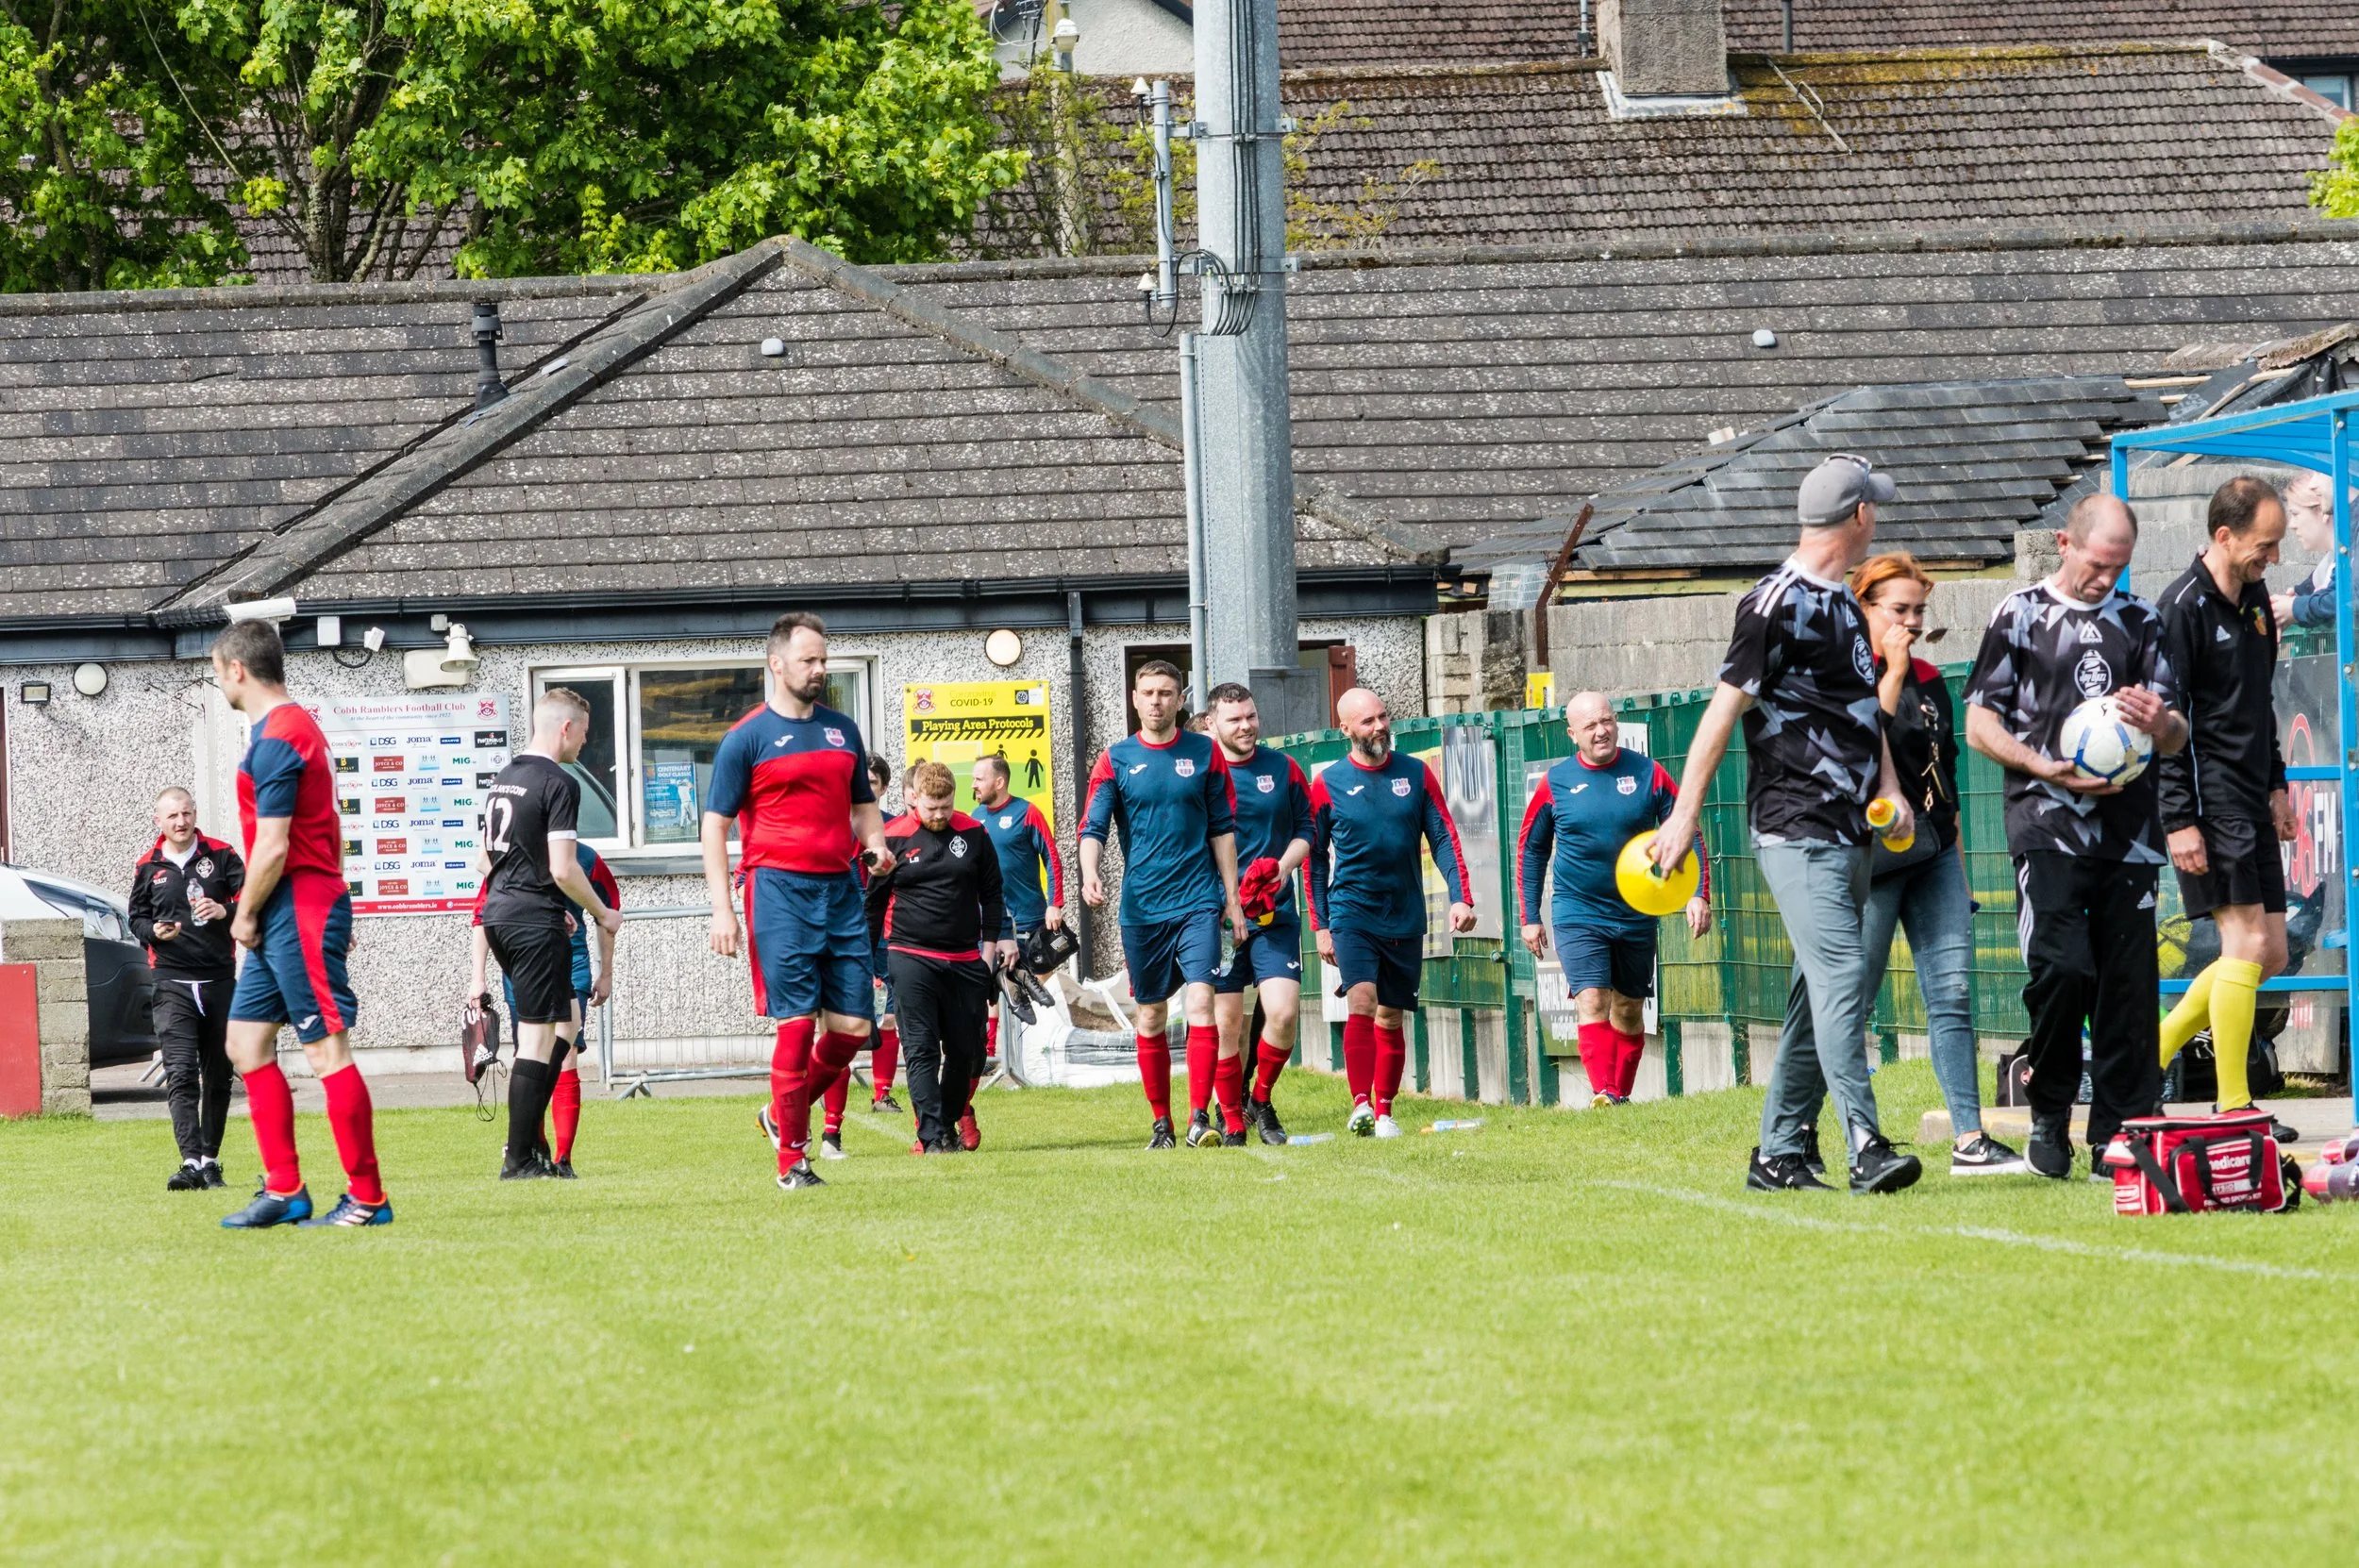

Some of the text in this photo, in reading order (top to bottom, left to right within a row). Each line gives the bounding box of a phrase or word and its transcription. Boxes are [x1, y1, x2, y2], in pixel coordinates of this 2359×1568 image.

[950, 698, 994, 708] COVID-19
[333, 702, 466, 715] Cobh Ramblers Football Club
[922, 717, 1034, 733] Playing Area Protocols
[378, 736, 396, 745] DSG
[379, 777, 397, 787] DSG
[381, 819, 399, 828] DSG
[485, 797, 512, 852] 12
[383, 861, 400, 870] DSG
